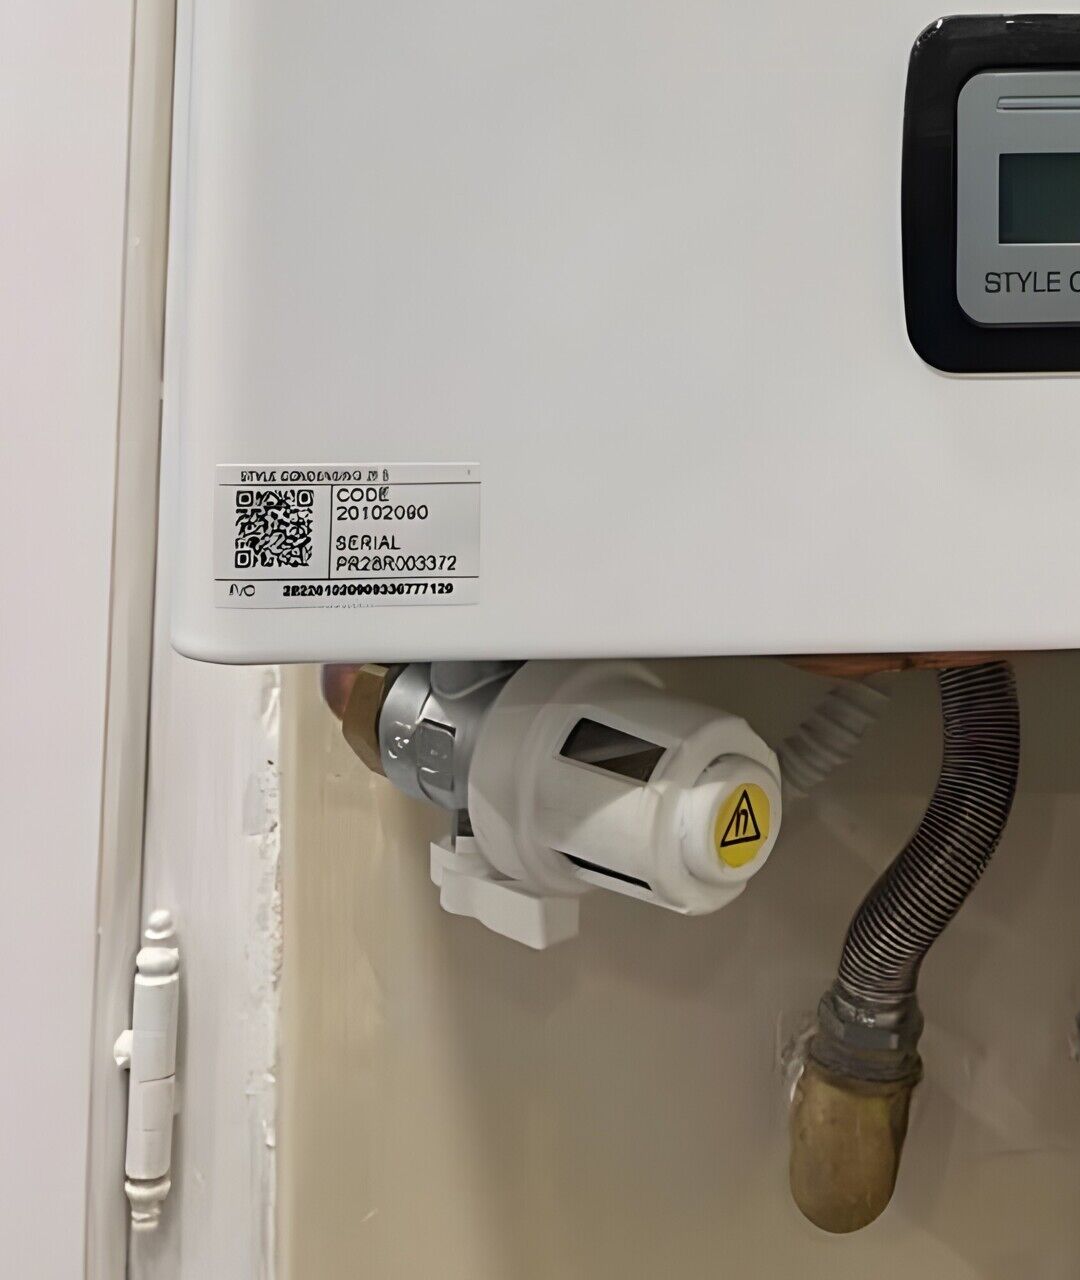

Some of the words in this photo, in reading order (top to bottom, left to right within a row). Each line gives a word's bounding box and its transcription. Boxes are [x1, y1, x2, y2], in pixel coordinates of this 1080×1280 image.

[984, 271, 1061, 294] STYLE
[336, 486, 390, 503] CODE
[335, 534, 401, 551] SERIAL
